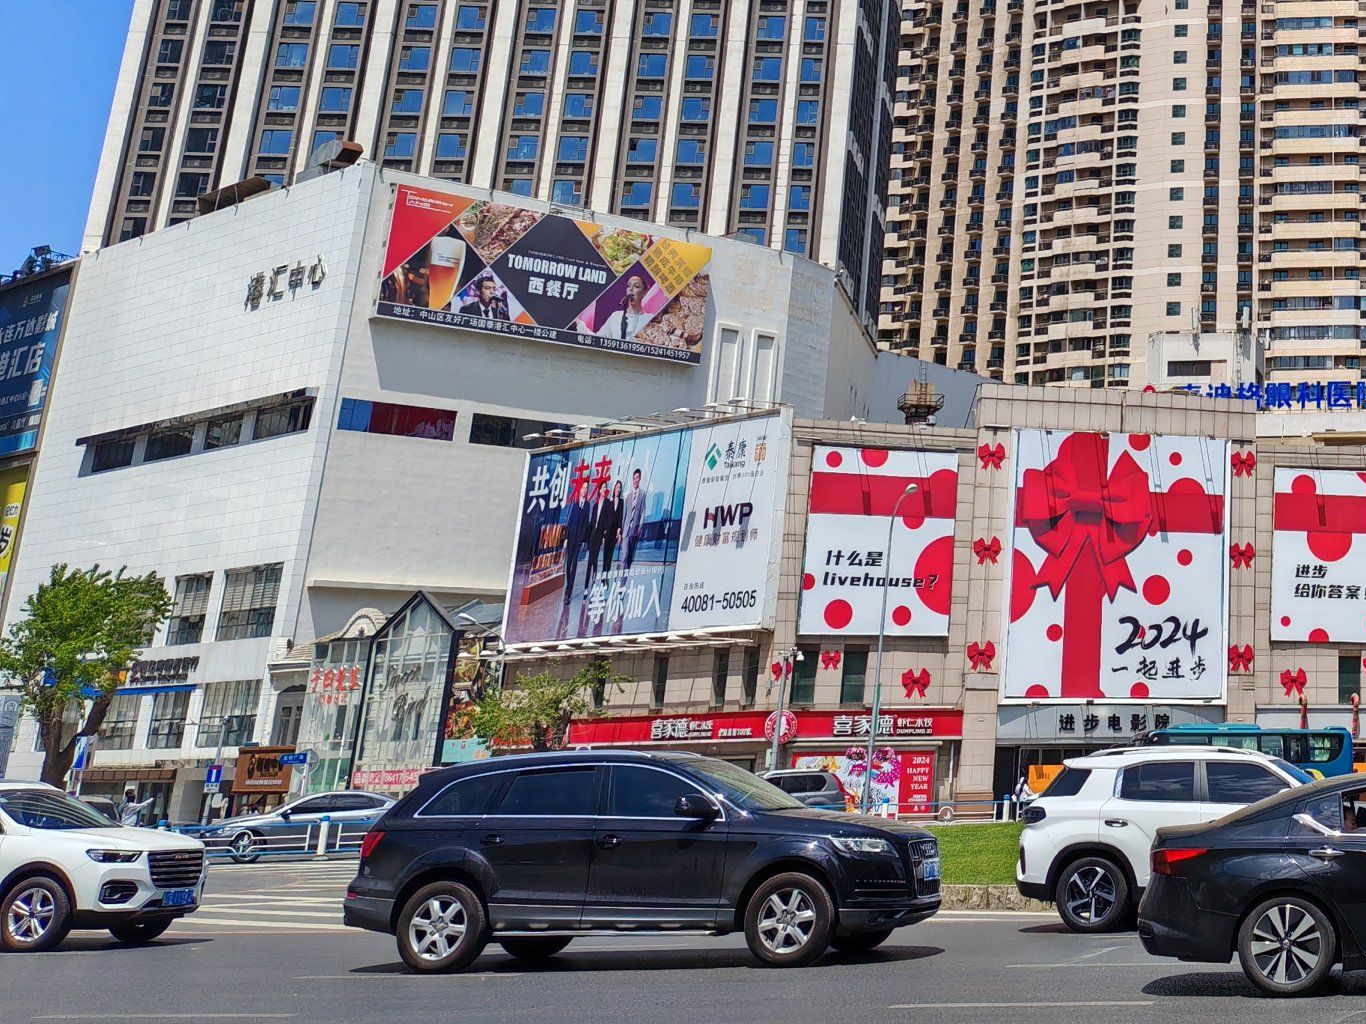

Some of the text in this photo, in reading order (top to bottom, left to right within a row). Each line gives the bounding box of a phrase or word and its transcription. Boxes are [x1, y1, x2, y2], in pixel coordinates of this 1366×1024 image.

[508, 253, 607, 285] TOMORROW LAND
[528, 276, 579, 300] 西餐厅
[725, 438, 747, 461] 泰康
[703, 502, 753, 529] HWP
[826, 550, 884, 567] 什么是
[823, 572, 938, 589] livehouse?
[1295, 563, 1328, 579] 进步
[587, 578, 661, 624] 等你加入
[681, 589, 757, 613] 40081-50505
[1115, 616, 1208, 656] 2024
[1111, 655, 1207, 681] 一起进步
[1059, 713, 1170, 732] 进步电影院
[912, 756, 930, 764] 2024
